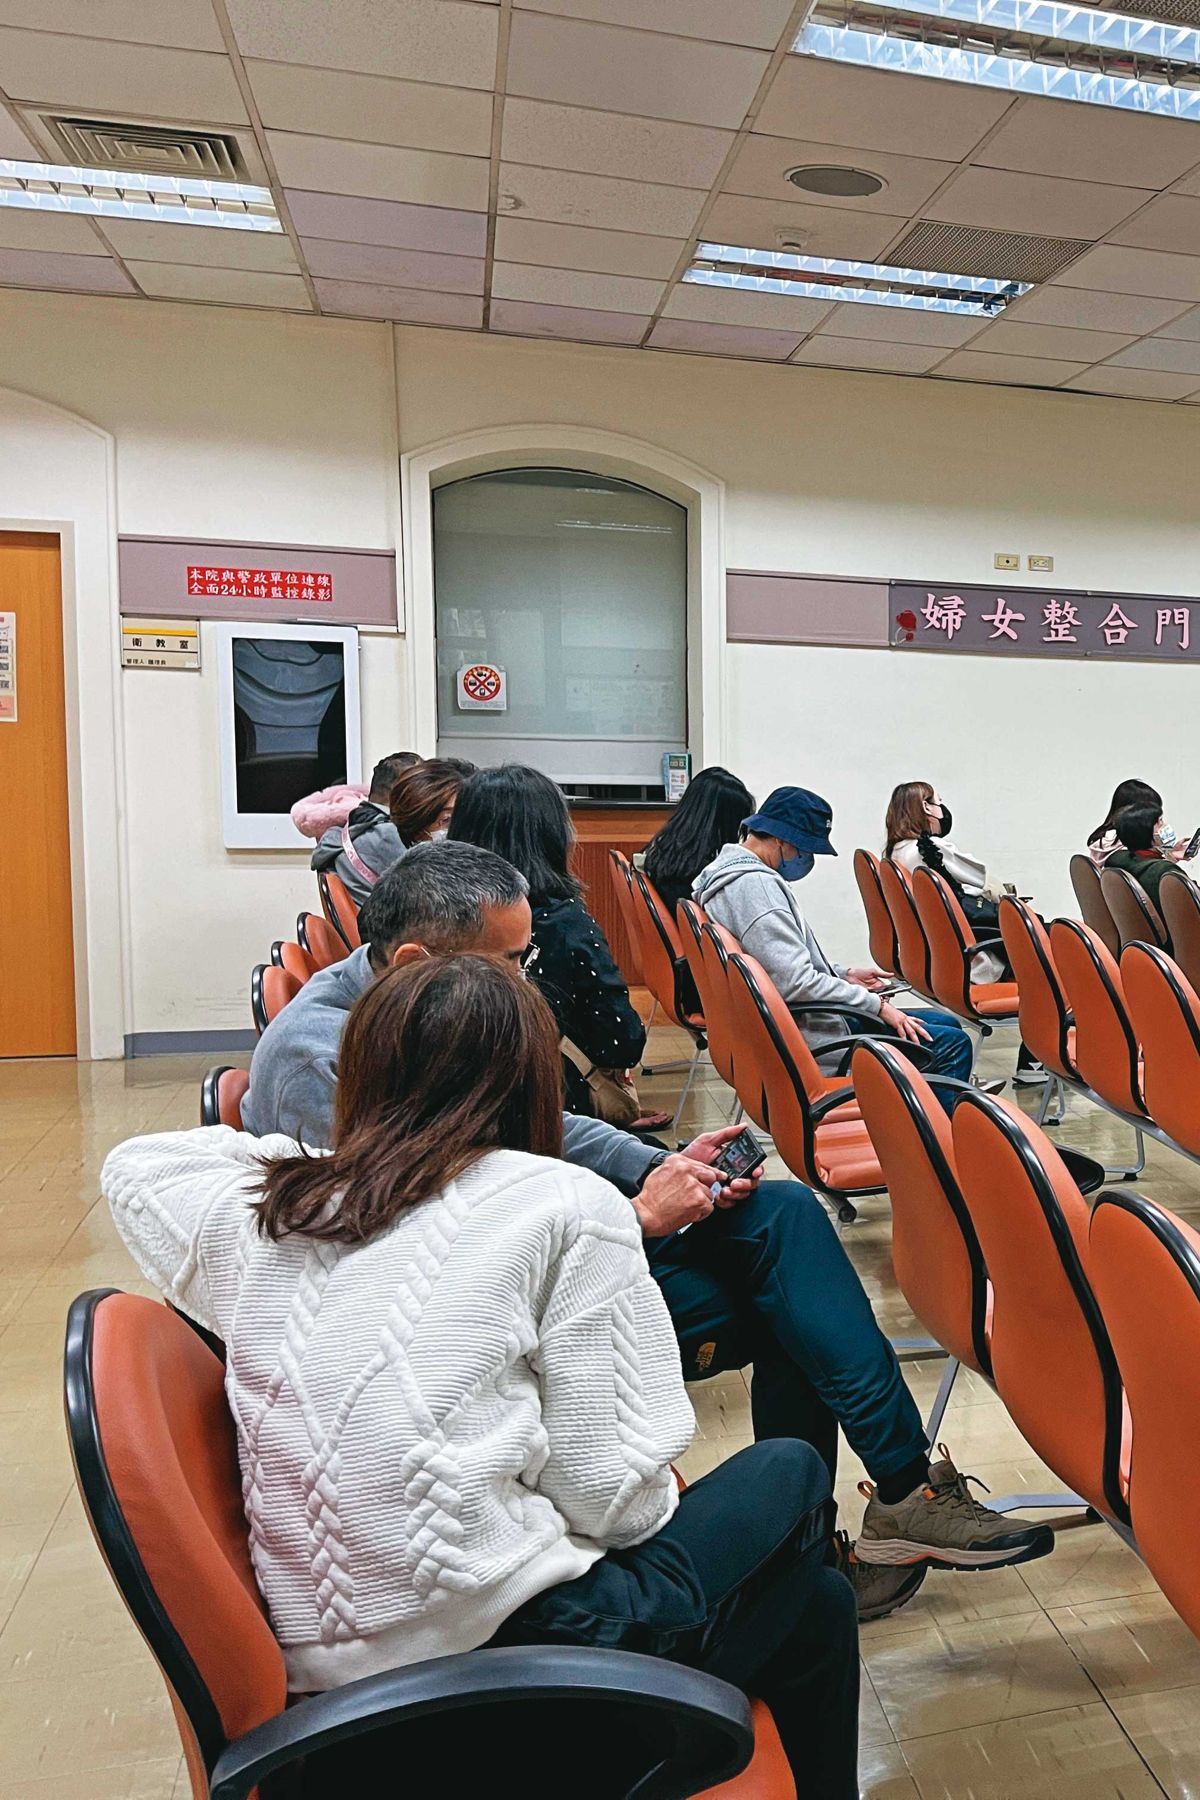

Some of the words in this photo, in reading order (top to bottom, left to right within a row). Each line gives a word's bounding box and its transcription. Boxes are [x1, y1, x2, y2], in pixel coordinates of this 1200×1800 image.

[190, 568, 331, 586] 本院與警政單位連線
[190, 582, 331, 600] 全面24小時監控錄影
[132, 637, 189, 650] 衛教室
